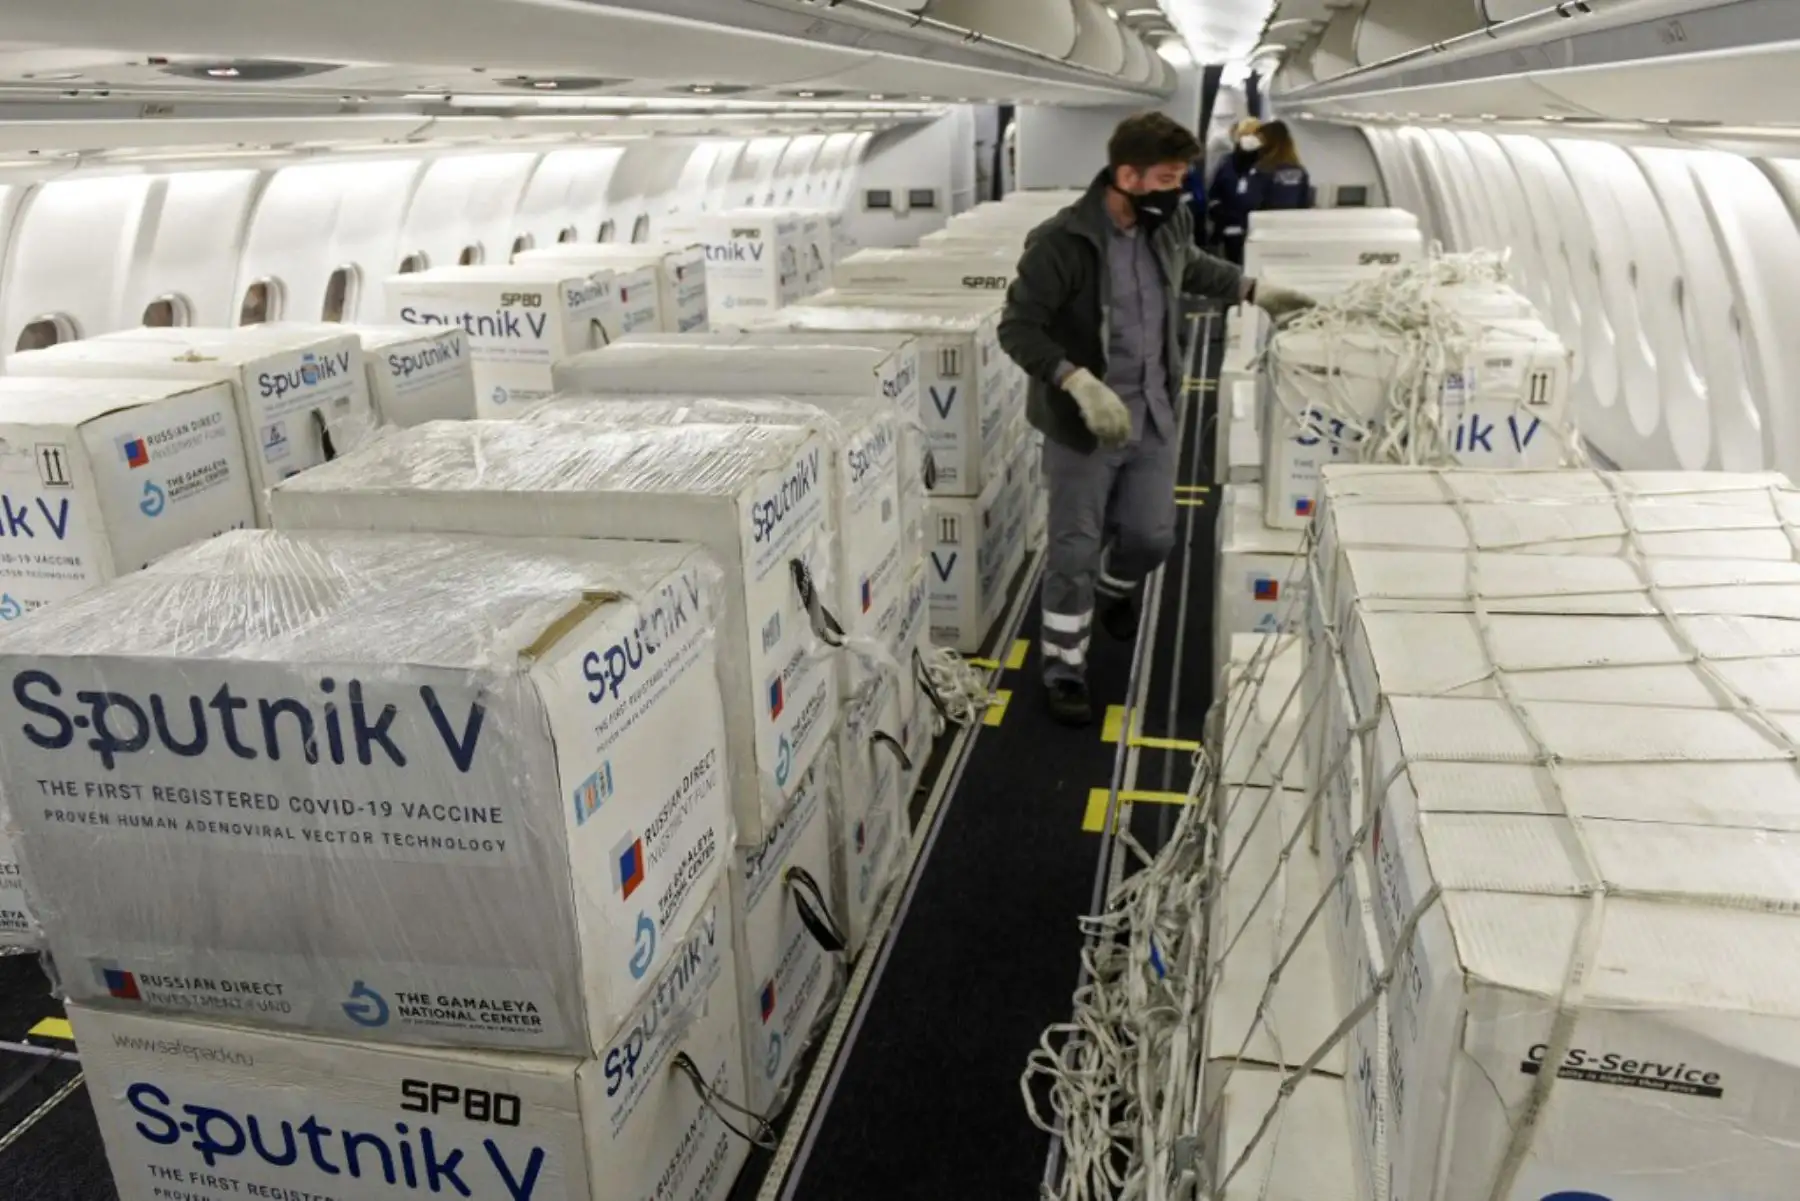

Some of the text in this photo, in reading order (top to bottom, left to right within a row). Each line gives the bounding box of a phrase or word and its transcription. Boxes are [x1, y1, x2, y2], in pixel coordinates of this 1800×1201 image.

[705, 240, 764, 261] tnik V
[525, 311, 546, 339] V
[258, 355, 337, 399] Sputnik
[336, 351, 349, 373] V
[388, 337, 460, 378] Sputnik V
[929, 385, 957, 420] V
[147, 424, 190, 446] RUSSIAN
[1507, 415, 1541, 454] V
[752, 457, 811, 543] Sputnik
[808, 448, 819, 484] V
[36, 496, 68, 540] V
[930, 551, 957, 583] V
[13, 669, 407, 770] Sputnik
[419, 684, 487, 773] V
[37, 780, 503, 824] THE FIRST REGISTERED COVID-19 VACCINE
[44, 809, 506, 852] PROVEN HUMAN ADENOVIRAL VECTOR TECHNOLOGY
[139, 974, 285, 996] RUSSIAN DIRECT
[395, 992, 538, 1014] THE GAMALEYA
[398, 1005, 543, 1026] NATIONAL CENTER
[1528, 1043, 1721, 1086] CS-Service
[401, 1078, 521, 1127] SP80
[126, 1082, 545, 1201] Sputnik V
[147, 1164, 185, 1183] THE
[189, 1171, 241, 1193] FIRST
